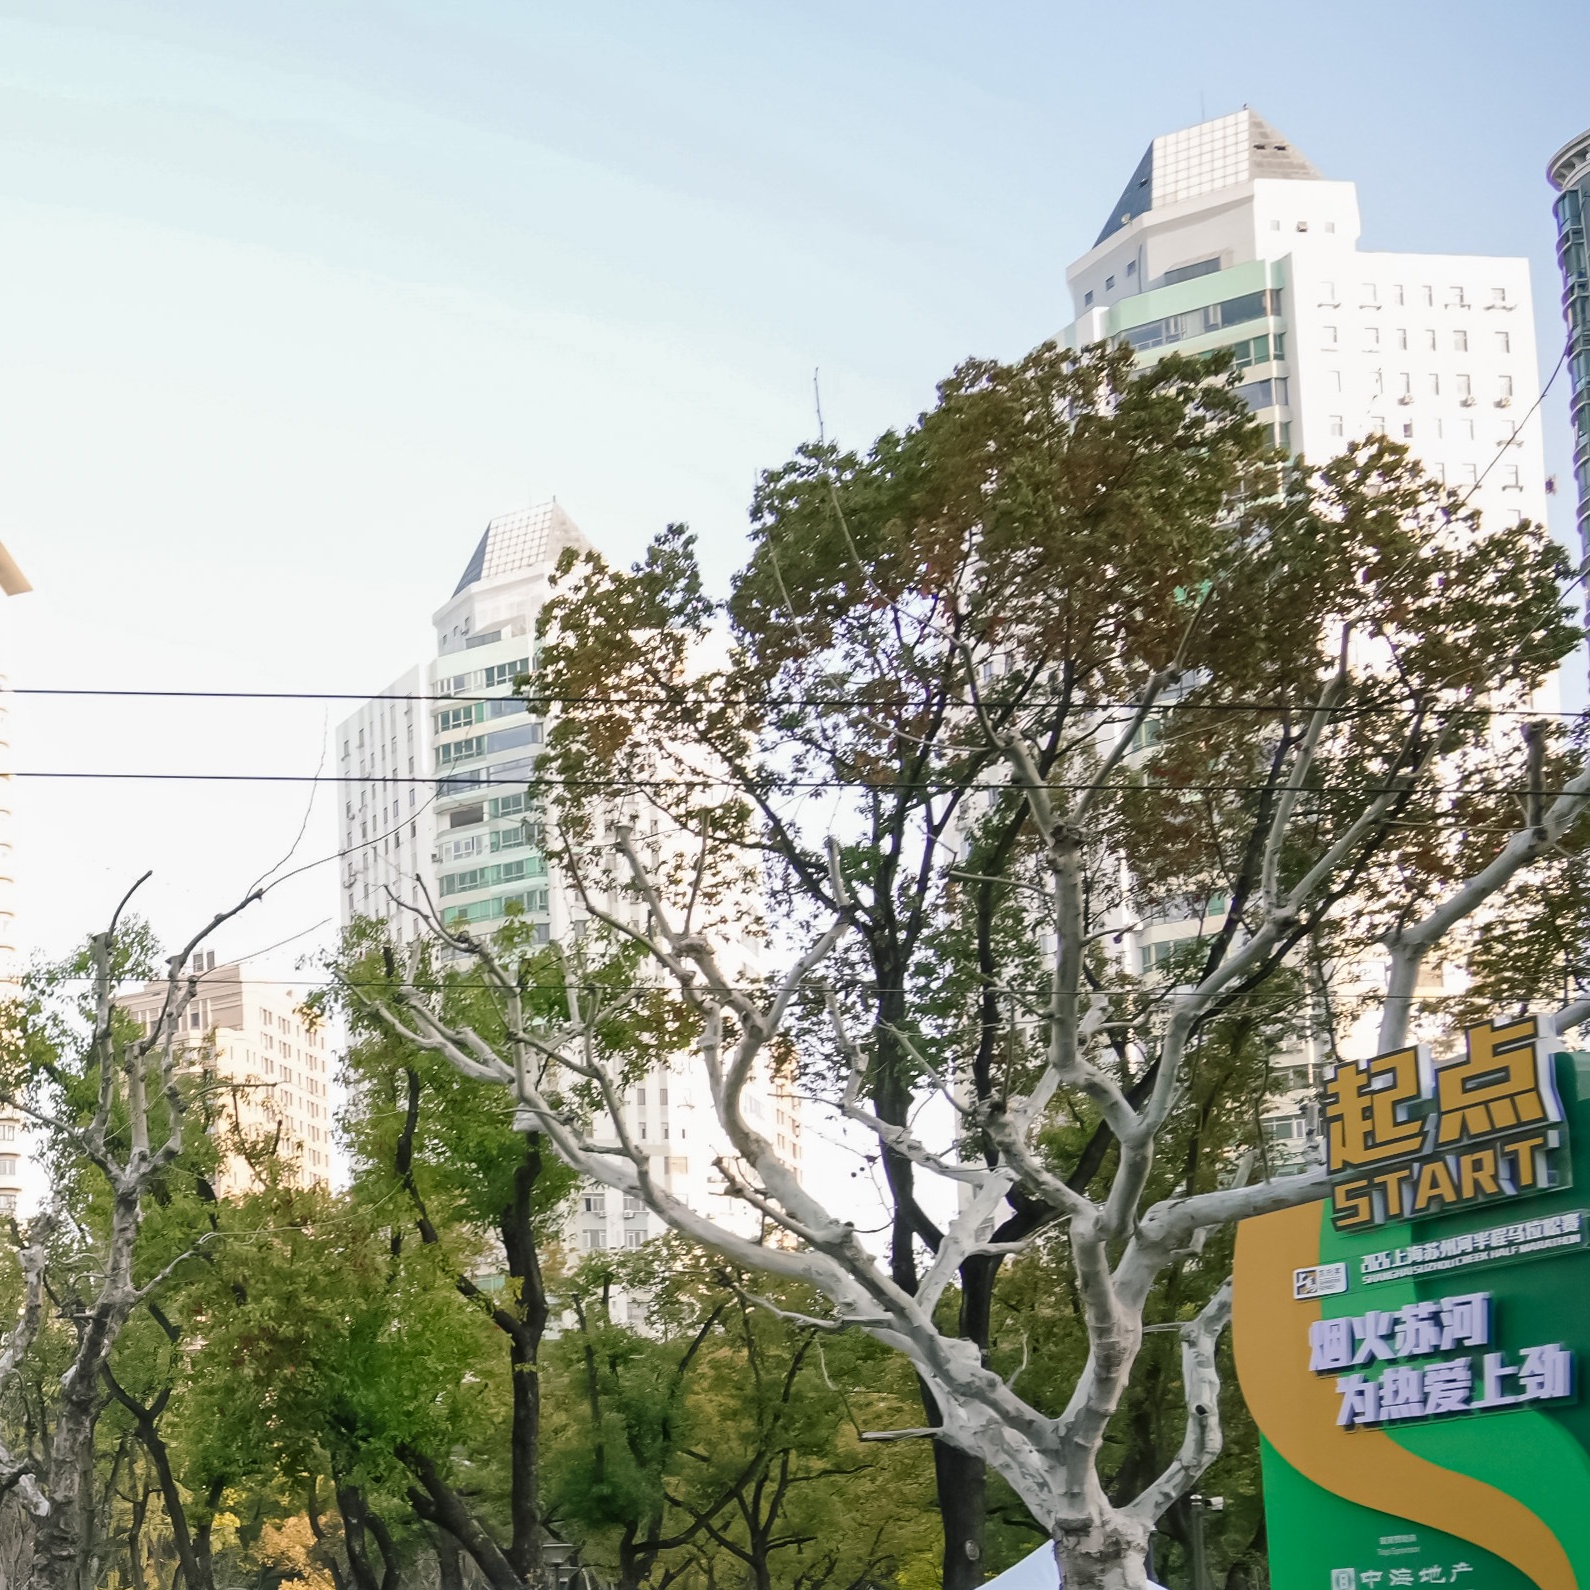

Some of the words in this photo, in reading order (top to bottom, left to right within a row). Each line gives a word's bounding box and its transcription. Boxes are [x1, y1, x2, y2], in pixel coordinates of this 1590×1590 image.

[1326, 1019, 1546, 1169] 起点
[1333, 1138, 1544, 1230] START
[1308, 1293, 1491, 1371] 烟火苏河
[1336, 1344, 1572, 1427] 为热爱上劲
[1359, 1562, 1473, 1589] 中海地产
